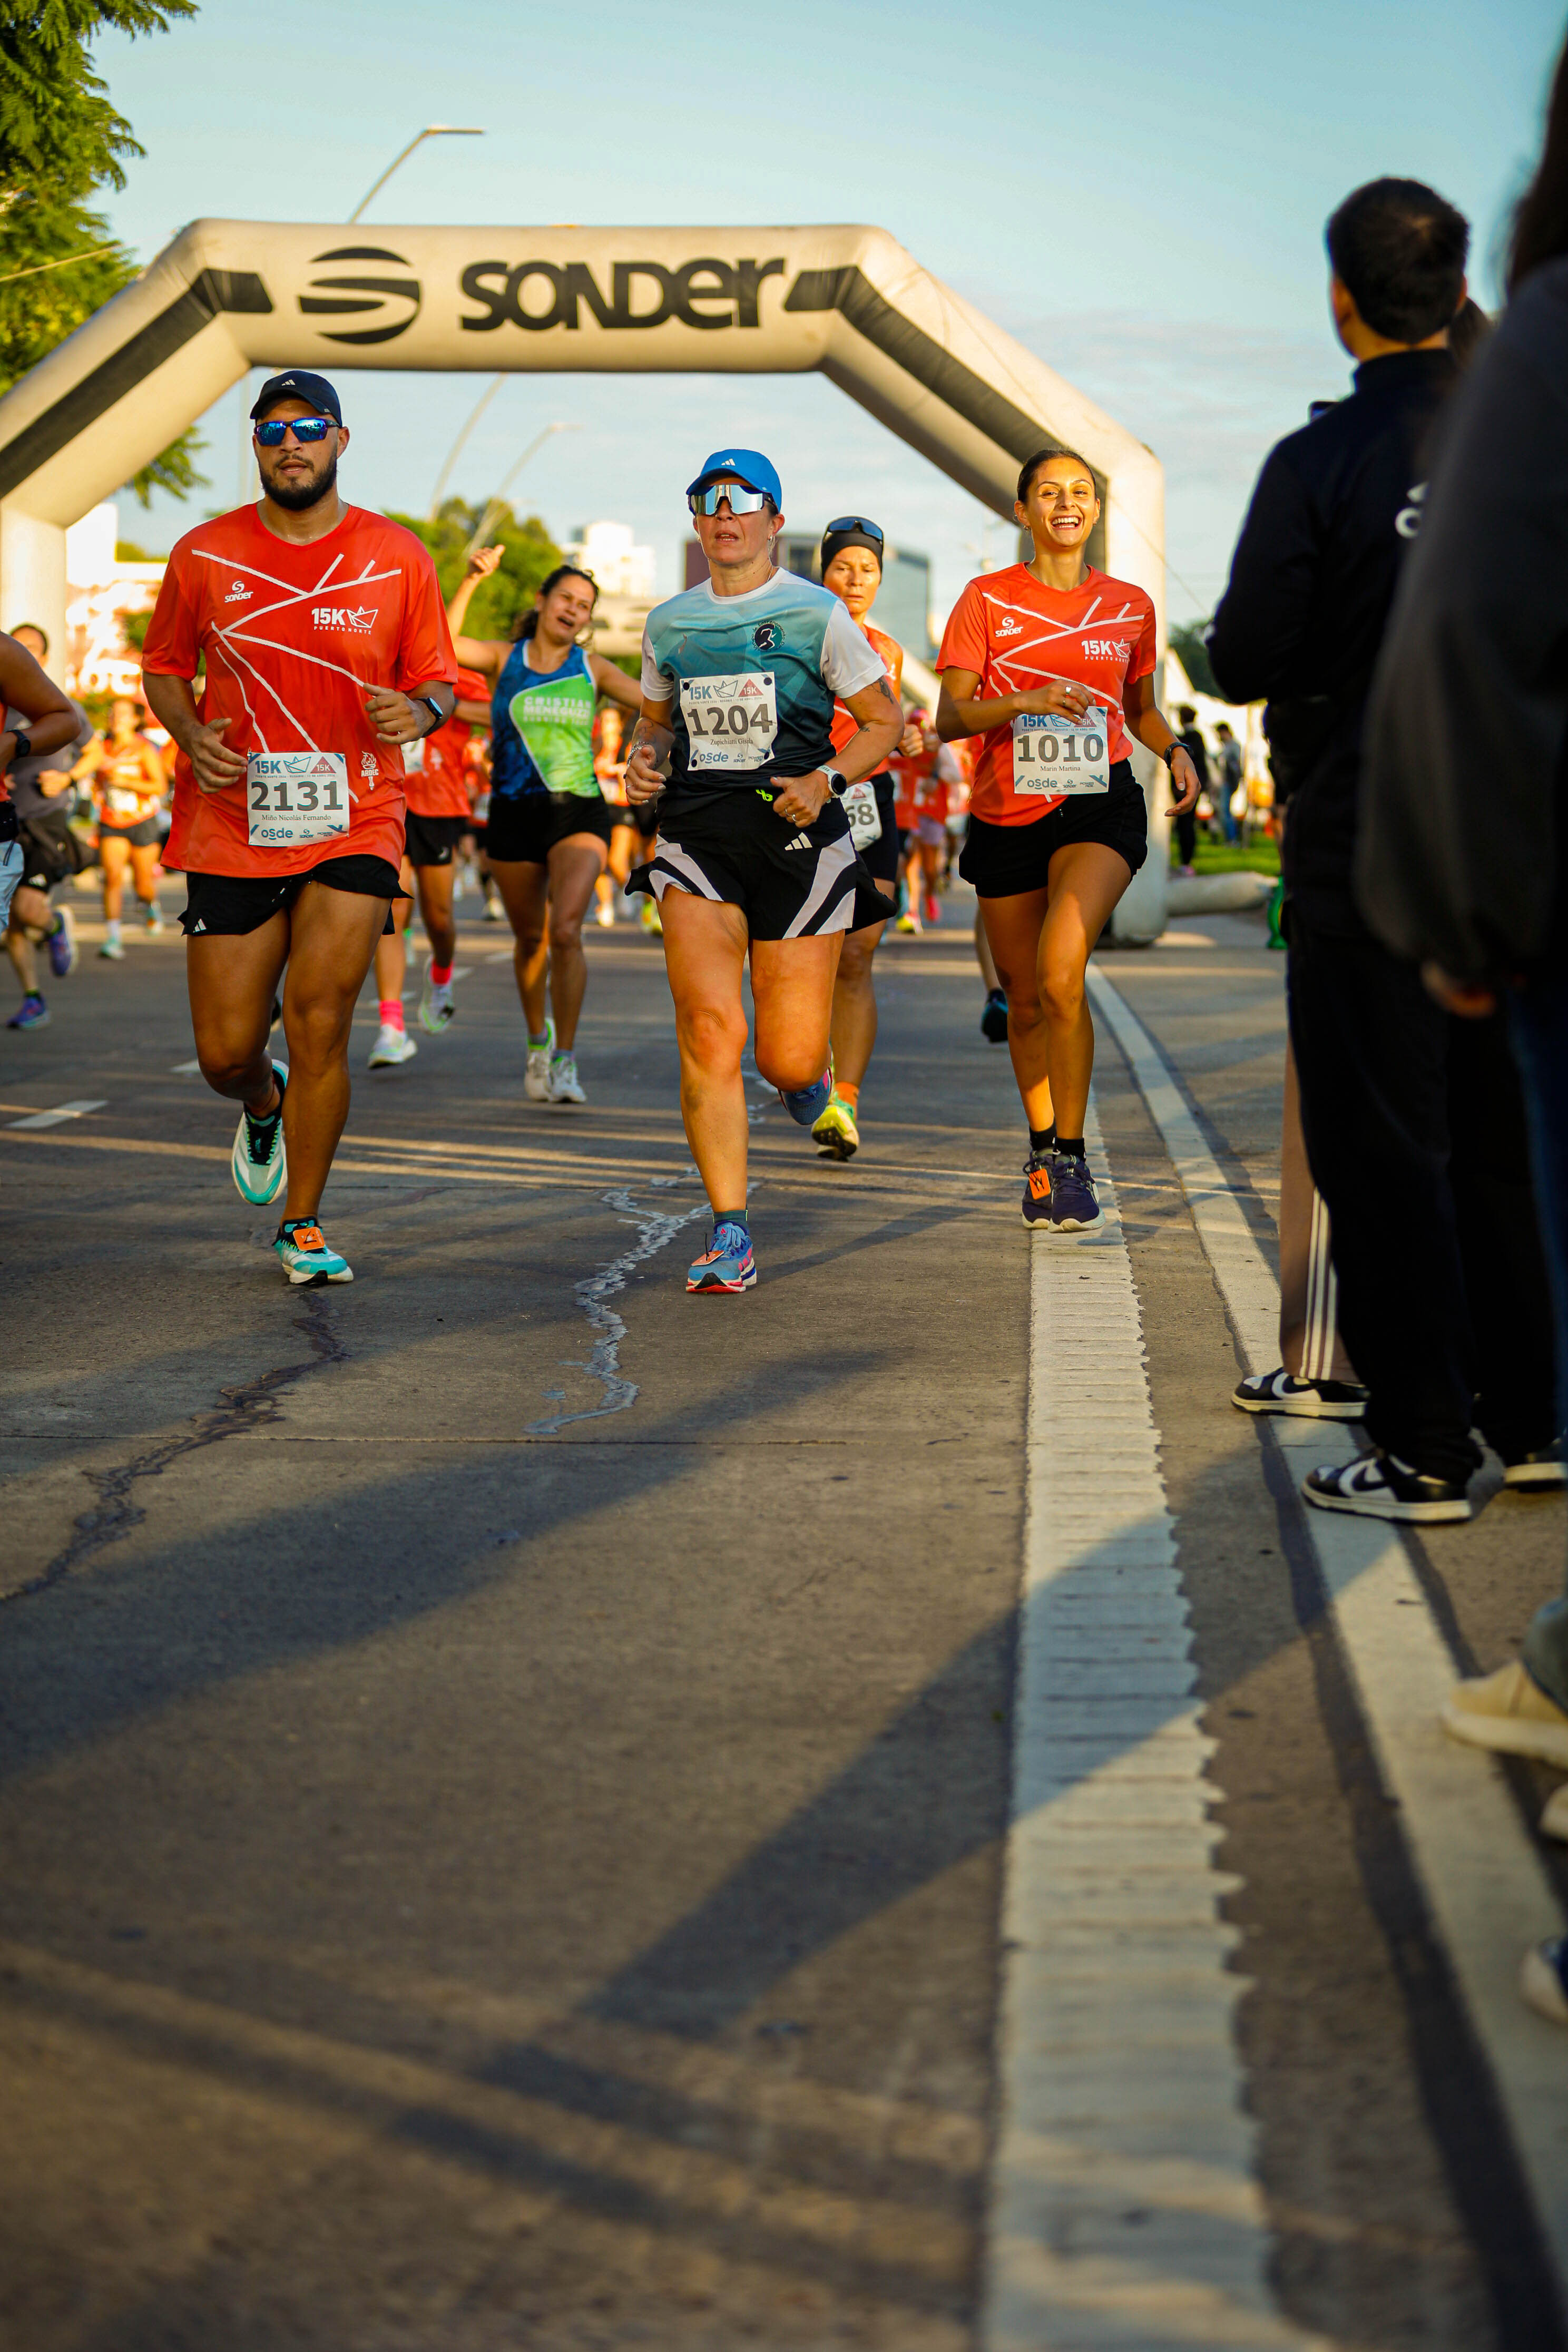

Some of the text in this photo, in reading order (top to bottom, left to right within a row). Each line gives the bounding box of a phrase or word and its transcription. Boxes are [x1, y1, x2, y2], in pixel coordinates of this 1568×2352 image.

[311, 608, 347, 625] 15K
[1081, 640, 1113, 655] 15K
[689, 685, 712, 700] 15K
[687, 703, 773, 736] 1204
[1022, 715, 1047, 727] 15K
[710, 738, 737, 747] Zupichiatti
[1017, 734, 1104, 762] 1010
[700, 752, 729, 763] osde
[255, 760, 281, 773] 15K
[1027, 778, 1057, 789] osde
[251, 781, 343, 811] 2131
[261, 828, 293, 840] osde
